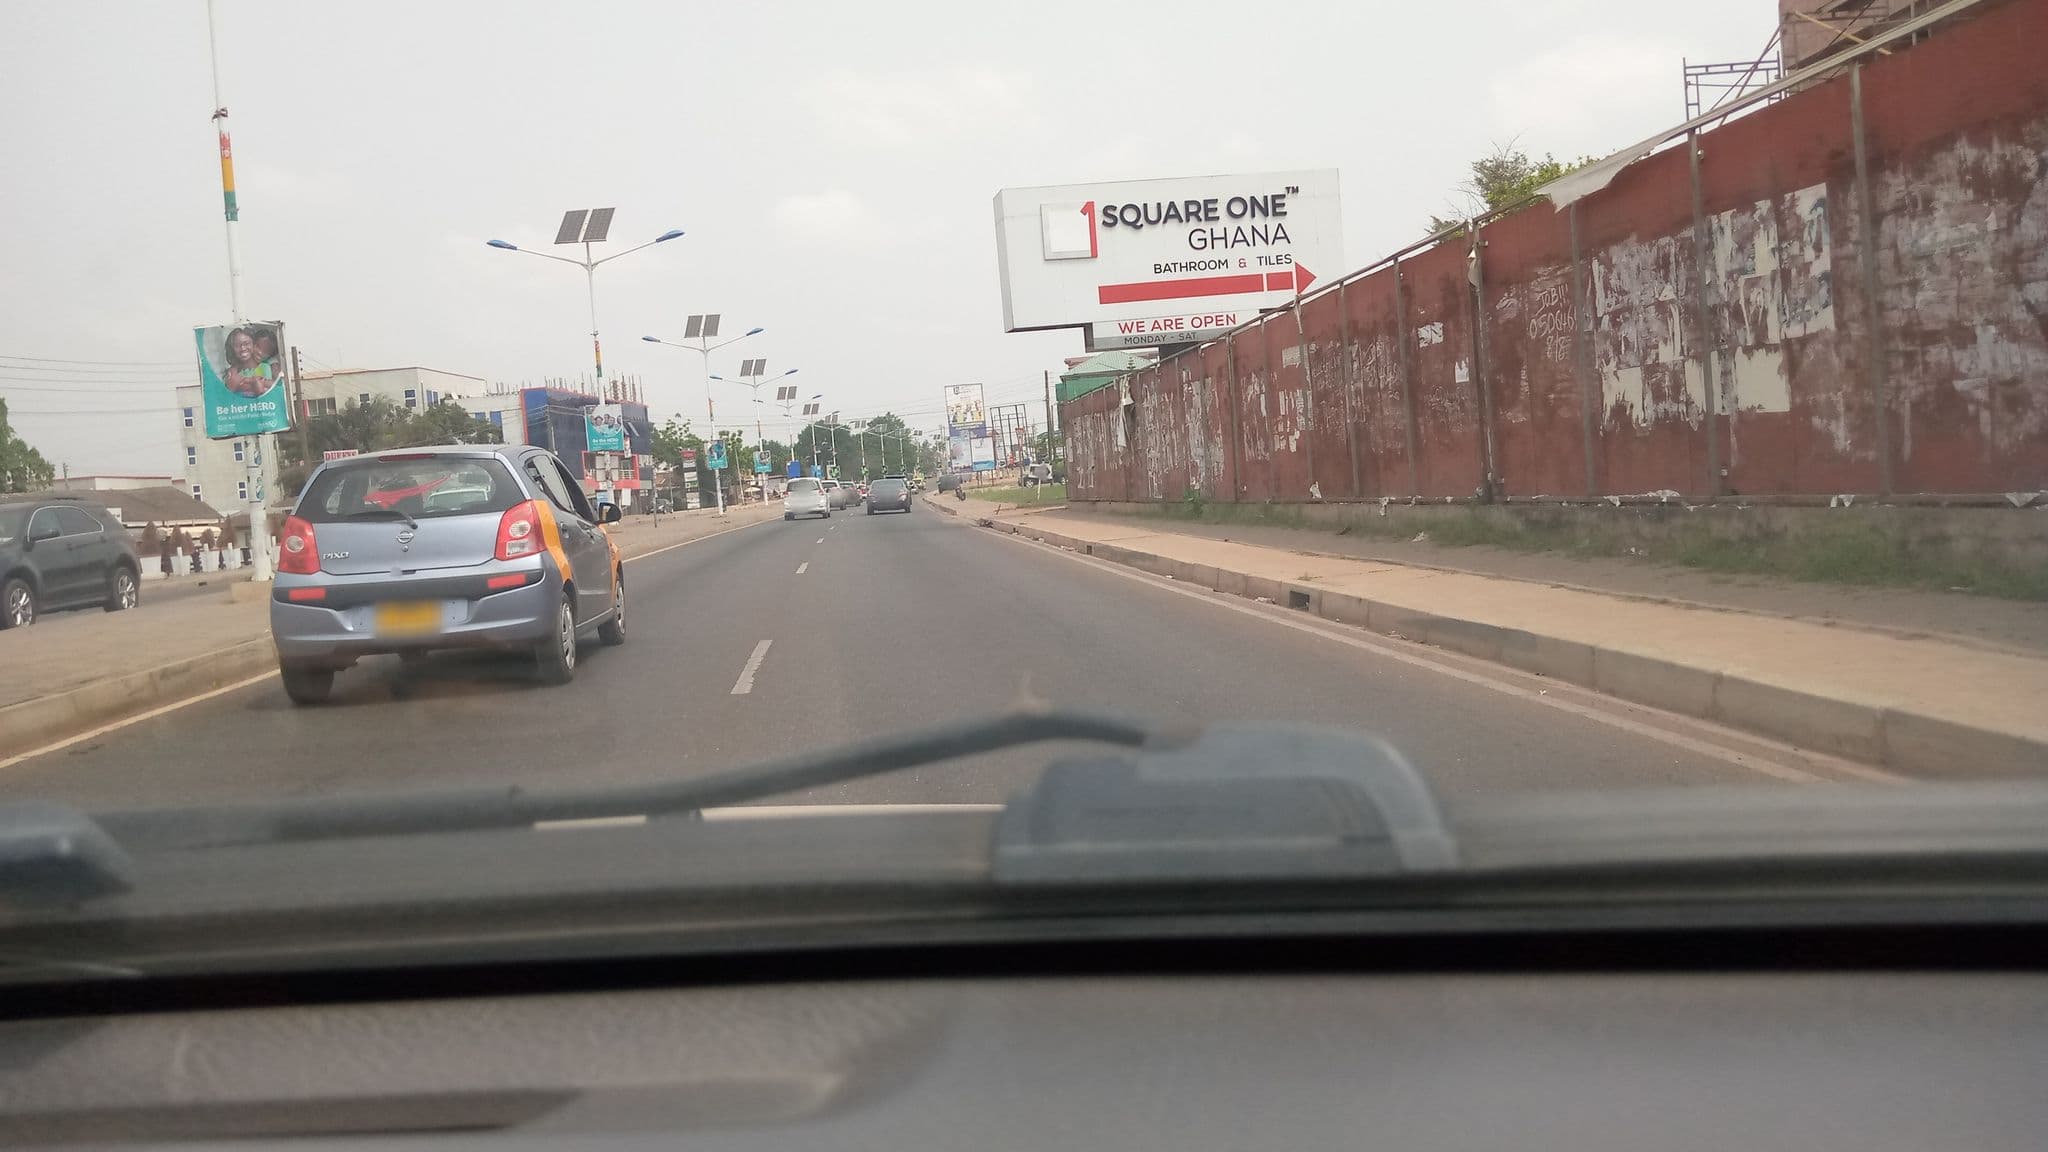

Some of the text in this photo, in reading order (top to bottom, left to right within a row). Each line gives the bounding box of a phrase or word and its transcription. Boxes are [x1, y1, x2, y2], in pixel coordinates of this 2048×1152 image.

[1101, 198, 1220, 230] SQUARE
[1226, 193, 1287, 219] ONE
[1188, 223, 1292, 251] GHANA
[1153, 253, 1293, 275] BATHROOM & TILES
[1118, 313, 1237, 334] WE ARE OPEN
[1124, 334, 1167, 345] MONDAY
[1178, 332, 1197, 341] SAT
[216, 401, 276, 415] Be her HERO
[323, 551, 350, 560] PIXO
